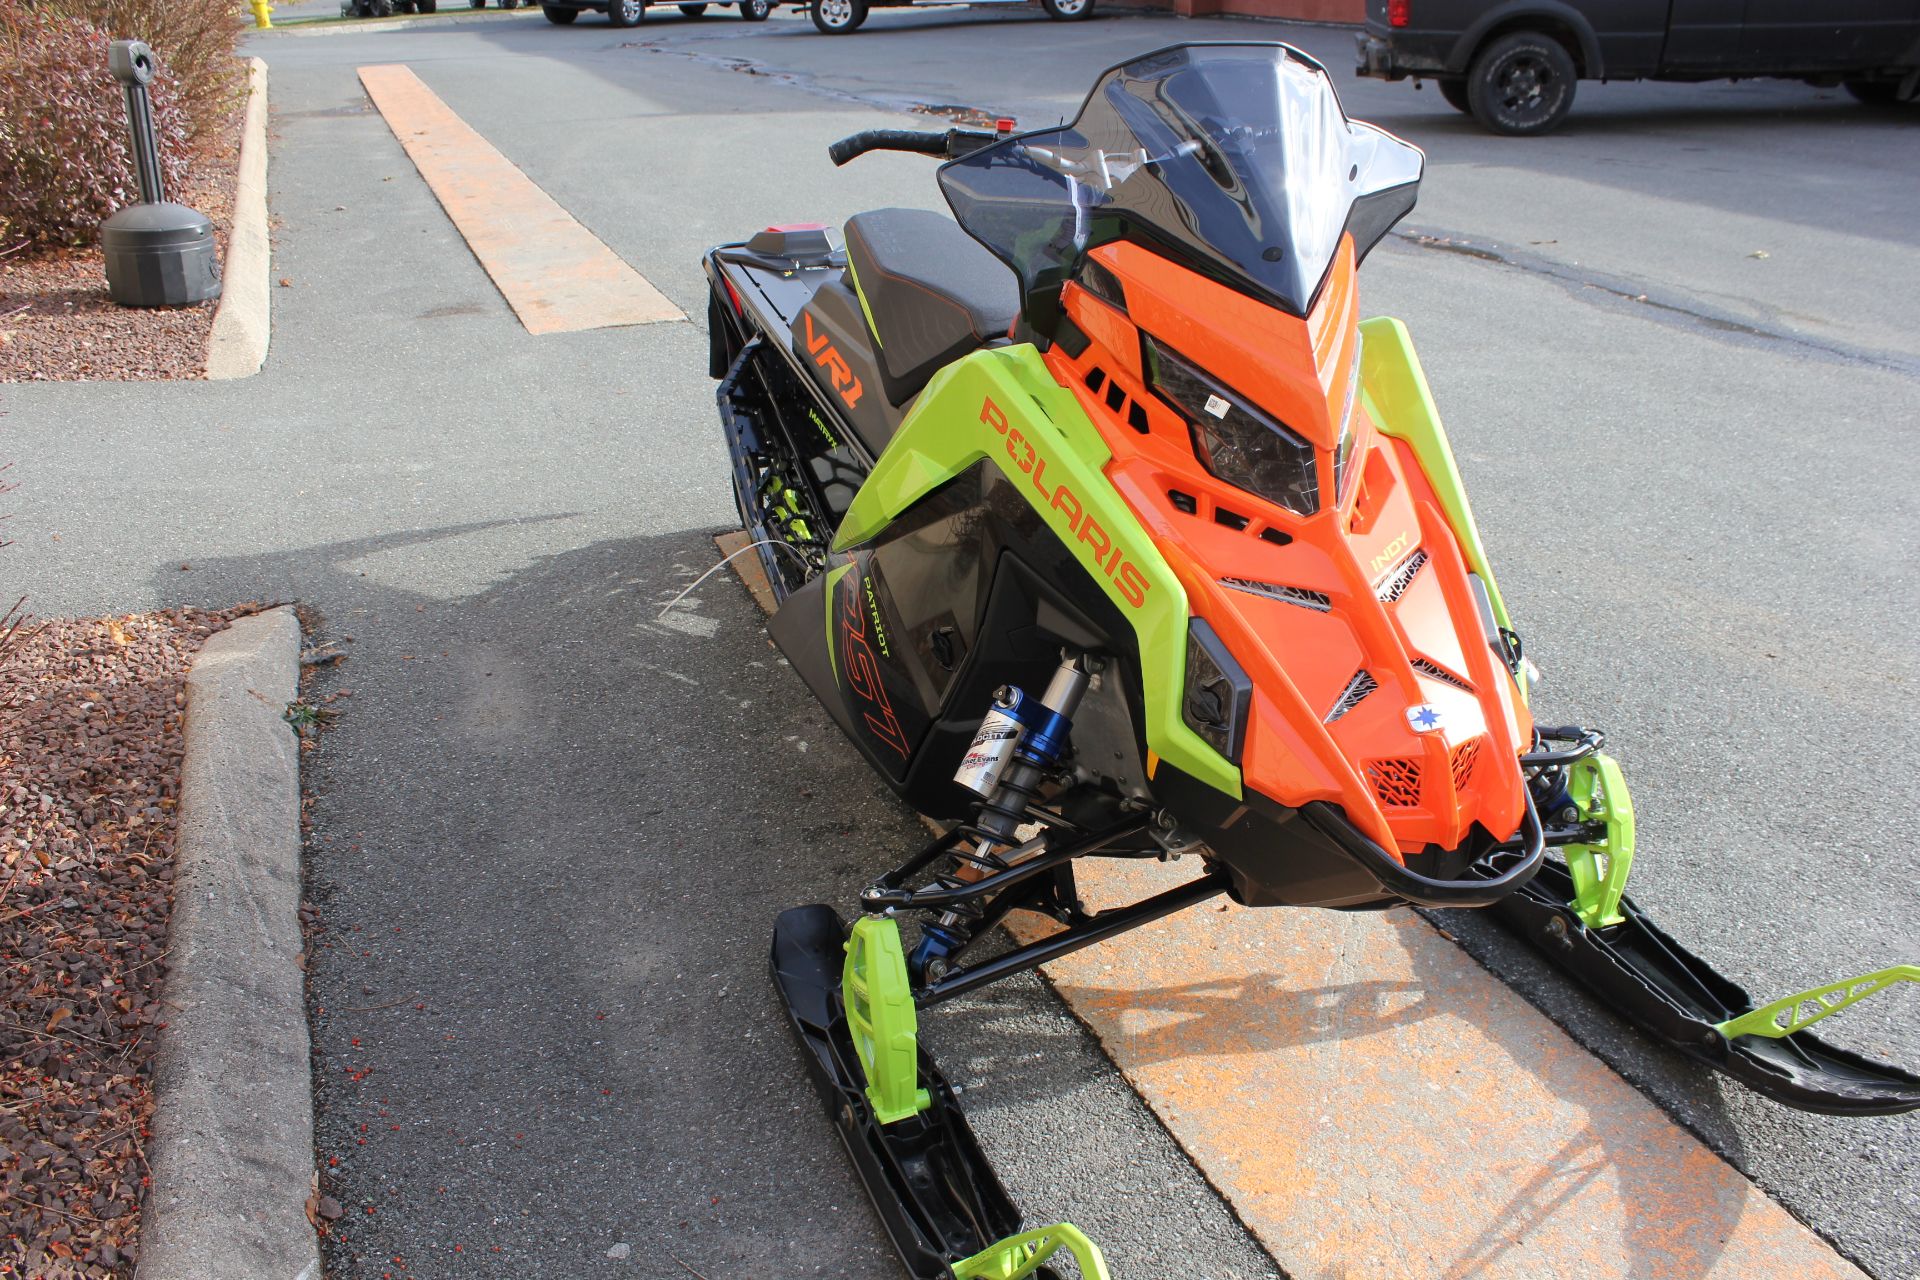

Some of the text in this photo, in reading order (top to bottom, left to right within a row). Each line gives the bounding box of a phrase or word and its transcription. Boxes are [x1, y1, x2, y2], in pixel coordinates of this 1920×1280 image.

[804, 308, 863, 410] VR1
[979, 395, 1151, 609] POLARIS
[1369, 530, 1408, 573] INDY
[863, 576, 890, 658] PATRIOT
